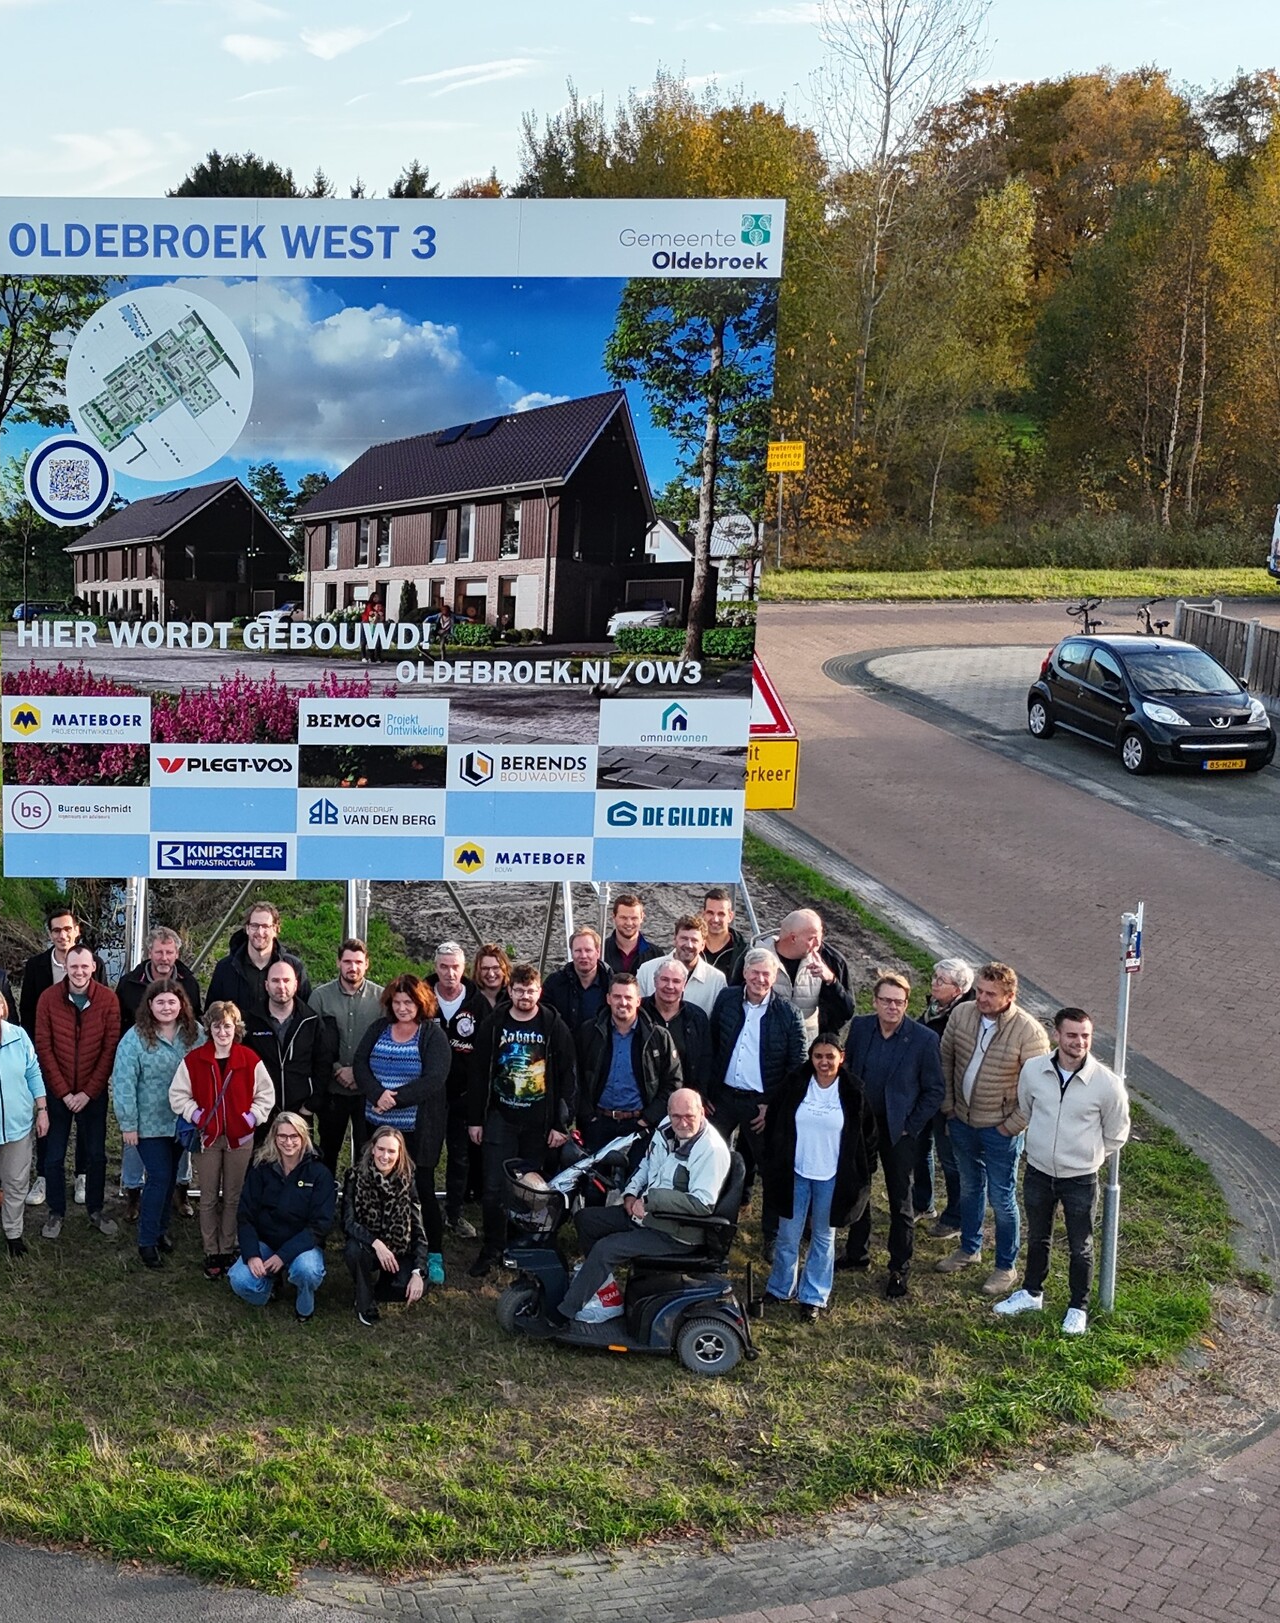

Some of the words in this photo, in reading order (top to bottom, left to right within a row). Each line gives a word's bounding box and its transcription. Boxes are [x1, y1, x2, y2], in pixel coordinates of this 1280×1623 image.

[9, 223, 267, 259] OLDEBROEK
[281, 225, 400, 260] WEST
[411, 225, 437, 260] 3
[619, 228, 736, 247] Gemeente
[652, 251, 769, 270] Oldebroek
[17, 621, 97, 648] HIER
[108, 622, 233, 649] WORDT
[242, 622, 431, 650] GEBOUWD!
[396, 660, 702, 688] OLDEBROEK.NL/OW3
[52, 714, 142, 727] MATEBOER
[306, 714, 381, 728] BEMOG
[387, 713, 419, 725] Projekt
[386, 724, 445, 738] Ontwikkeling
[640, 734, 708, 743] omniawonen
[187, 758, 293, 773] PLEGT-VOS
[501, 756, 587, 771] BERENDS
[500, 772, 586, 783] BOUWADVIES
[21, 802, 42, 818] bs
[58, 804, 91, 813] Bureau
[93, 804, 132, 813] Schmidt
[343, 814, 369, 825] VAN
[372, 815, 399, 825] DEN
[402, 815, 436, 826] BERG
[642, 807, 665, 827] DE
[668, 807, 733, 827] GILDEN
[187, 845, 283, 859] KNIPSCHEER
[495, 852, 586, 865] MATEBOER
